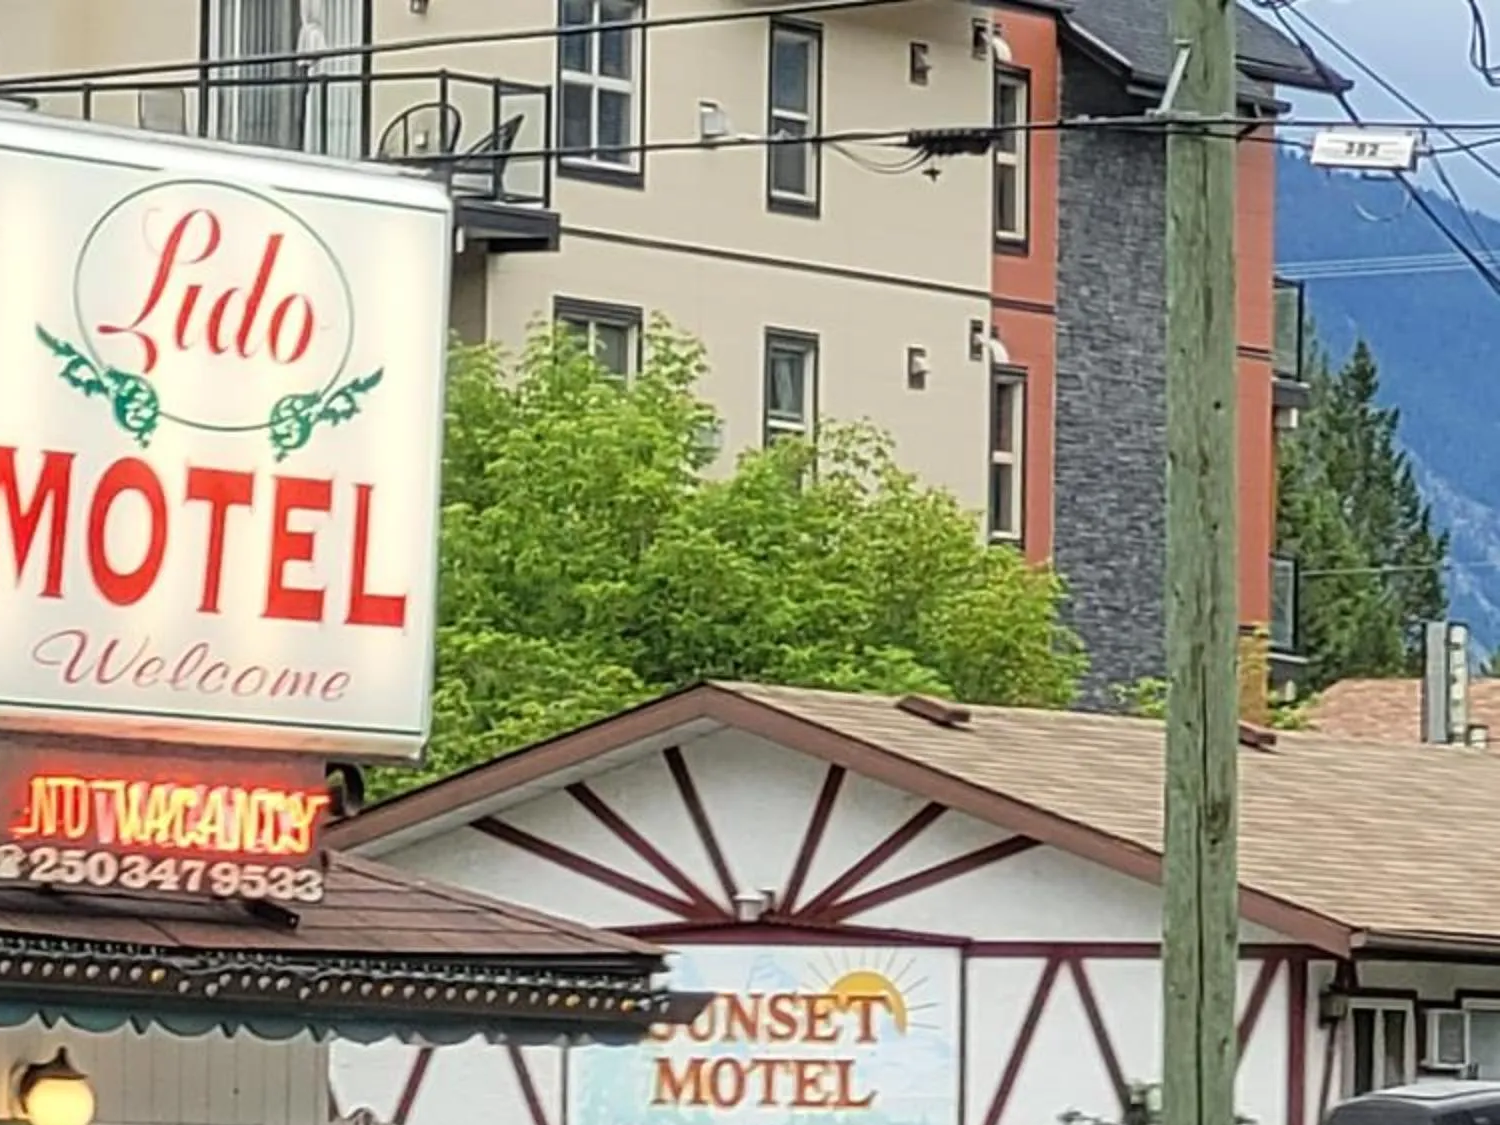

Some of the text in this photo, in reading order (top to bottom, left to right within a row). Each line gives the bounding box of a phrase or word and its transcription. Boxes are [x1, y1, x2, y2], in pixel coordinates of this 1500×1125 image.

[97, 208, 313, 374] Lido
[32, 628, 351, 702] Welcome
[650, 1056, 877, 1109] MOTEL
